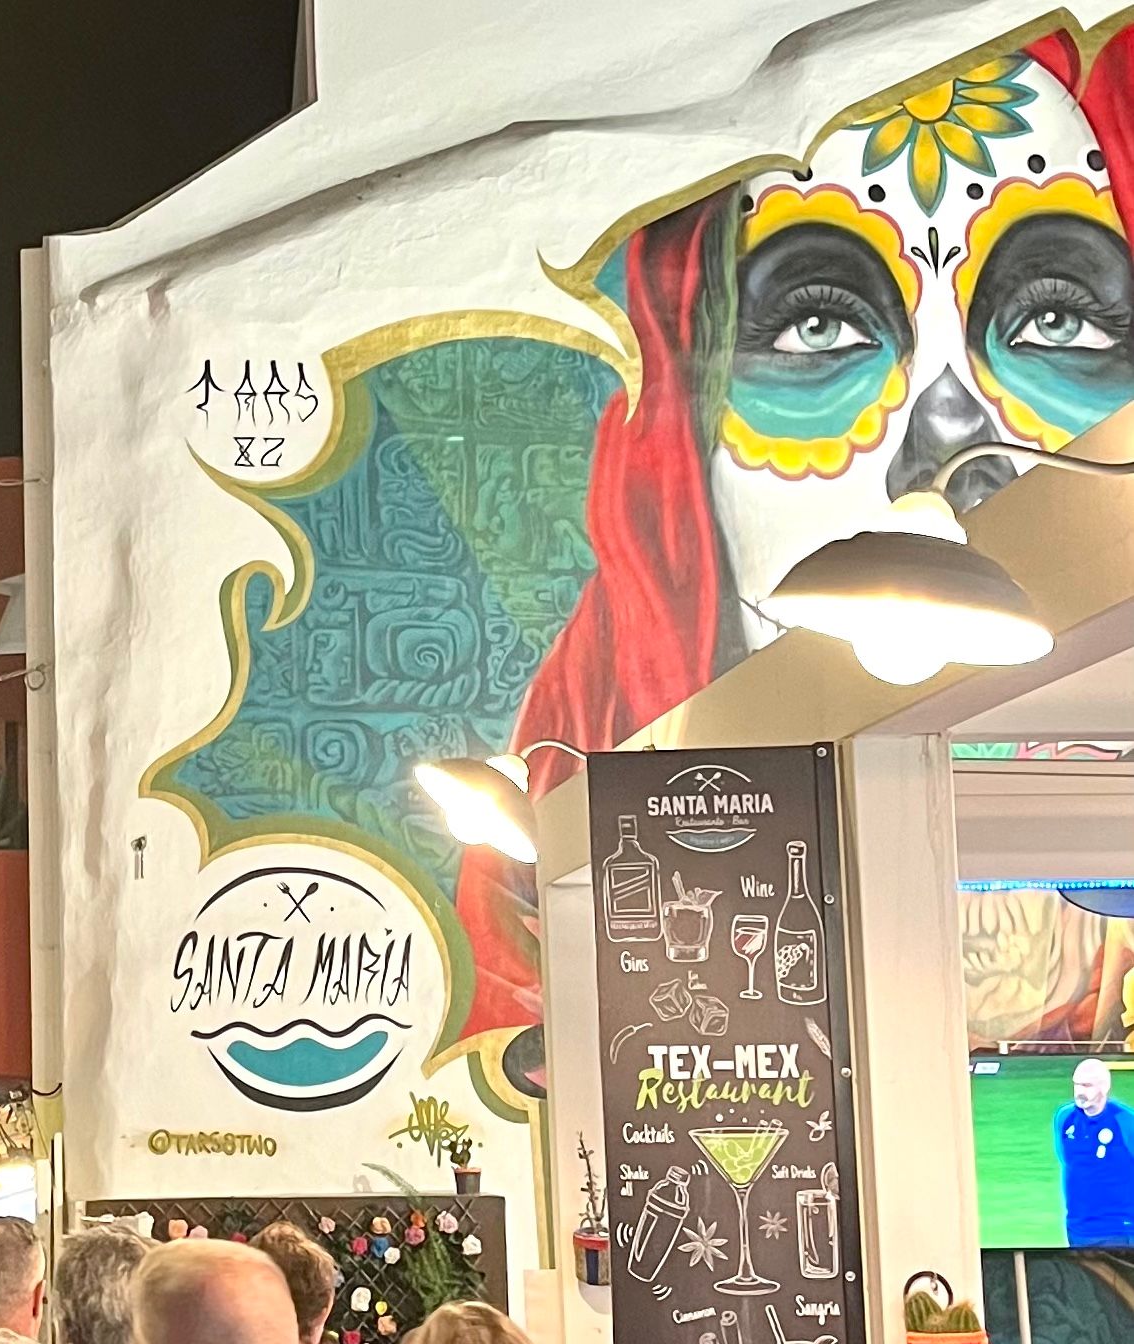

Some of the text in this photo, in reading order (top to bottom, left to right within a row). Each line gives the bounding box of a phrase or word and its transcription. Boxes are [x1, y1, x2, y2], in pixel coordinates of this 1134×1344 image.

[646, 793, 774, 816] SANTA MARIA
[740, 874, 775, 898] Wine
[170, 927, 413, 1013] SANTA MARIA
[620, 950, 650, 973] Gins
[647, 1043, 801, 1080] TEX-MEX
[635, 1068, 815, 1114] Restaurant
[622, 1122, 676, 1144] Cocktails
[619, 1163, 649, 1180] Shake
[771, 1164, 817, 1180] Soft Drinks
[620, 1181, 634, 1197] all
[795, 1295, 841, 1326] Sangria
